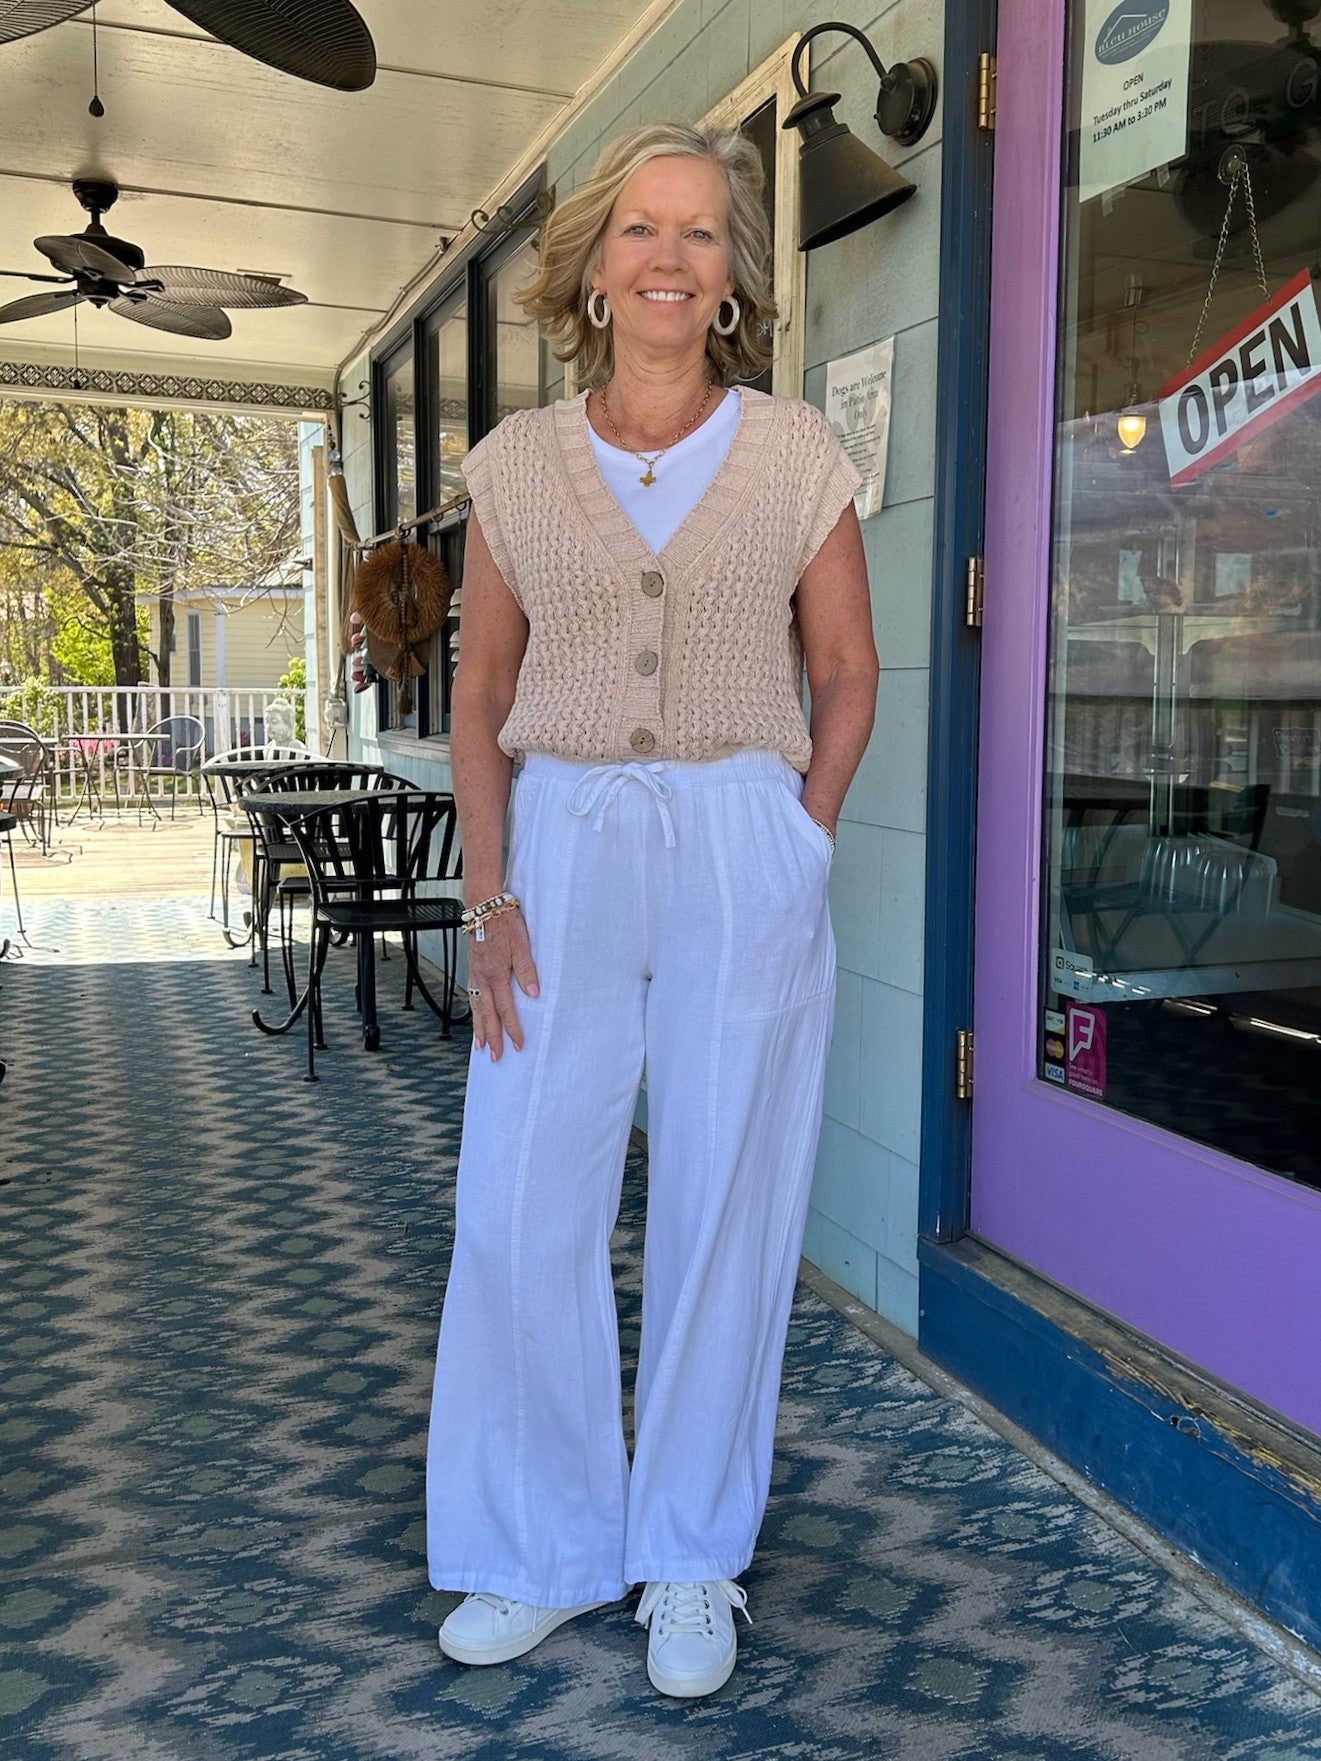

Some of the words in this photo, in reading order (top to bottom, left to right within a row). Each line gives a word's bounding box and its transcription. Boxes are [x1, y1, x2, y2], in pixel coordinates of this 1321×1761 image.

[1122, 72, 1144, 91] OPEN
[1093, 104, 1122, 125] Tuesday
[1123, 97, 1139, 111] thru
[1139, 77, 1172, 103] Saturday
[1092, 125, 1112, 143] 11:30
[1112, 118, 1127, 134] AM
[1128, 115, 1137, 126] to
[1137, 104, 1153, 122] 3:30
[1153, 97, 1167, 113] PM
[832, 386, 848, 397] Dogs
[850, 381, 861, 392] are
[861, 371, 886, 387] Welcome
[1177, 301, 1312, 456] OPEN
[1047, 1066, 1064, 1080] VISA
